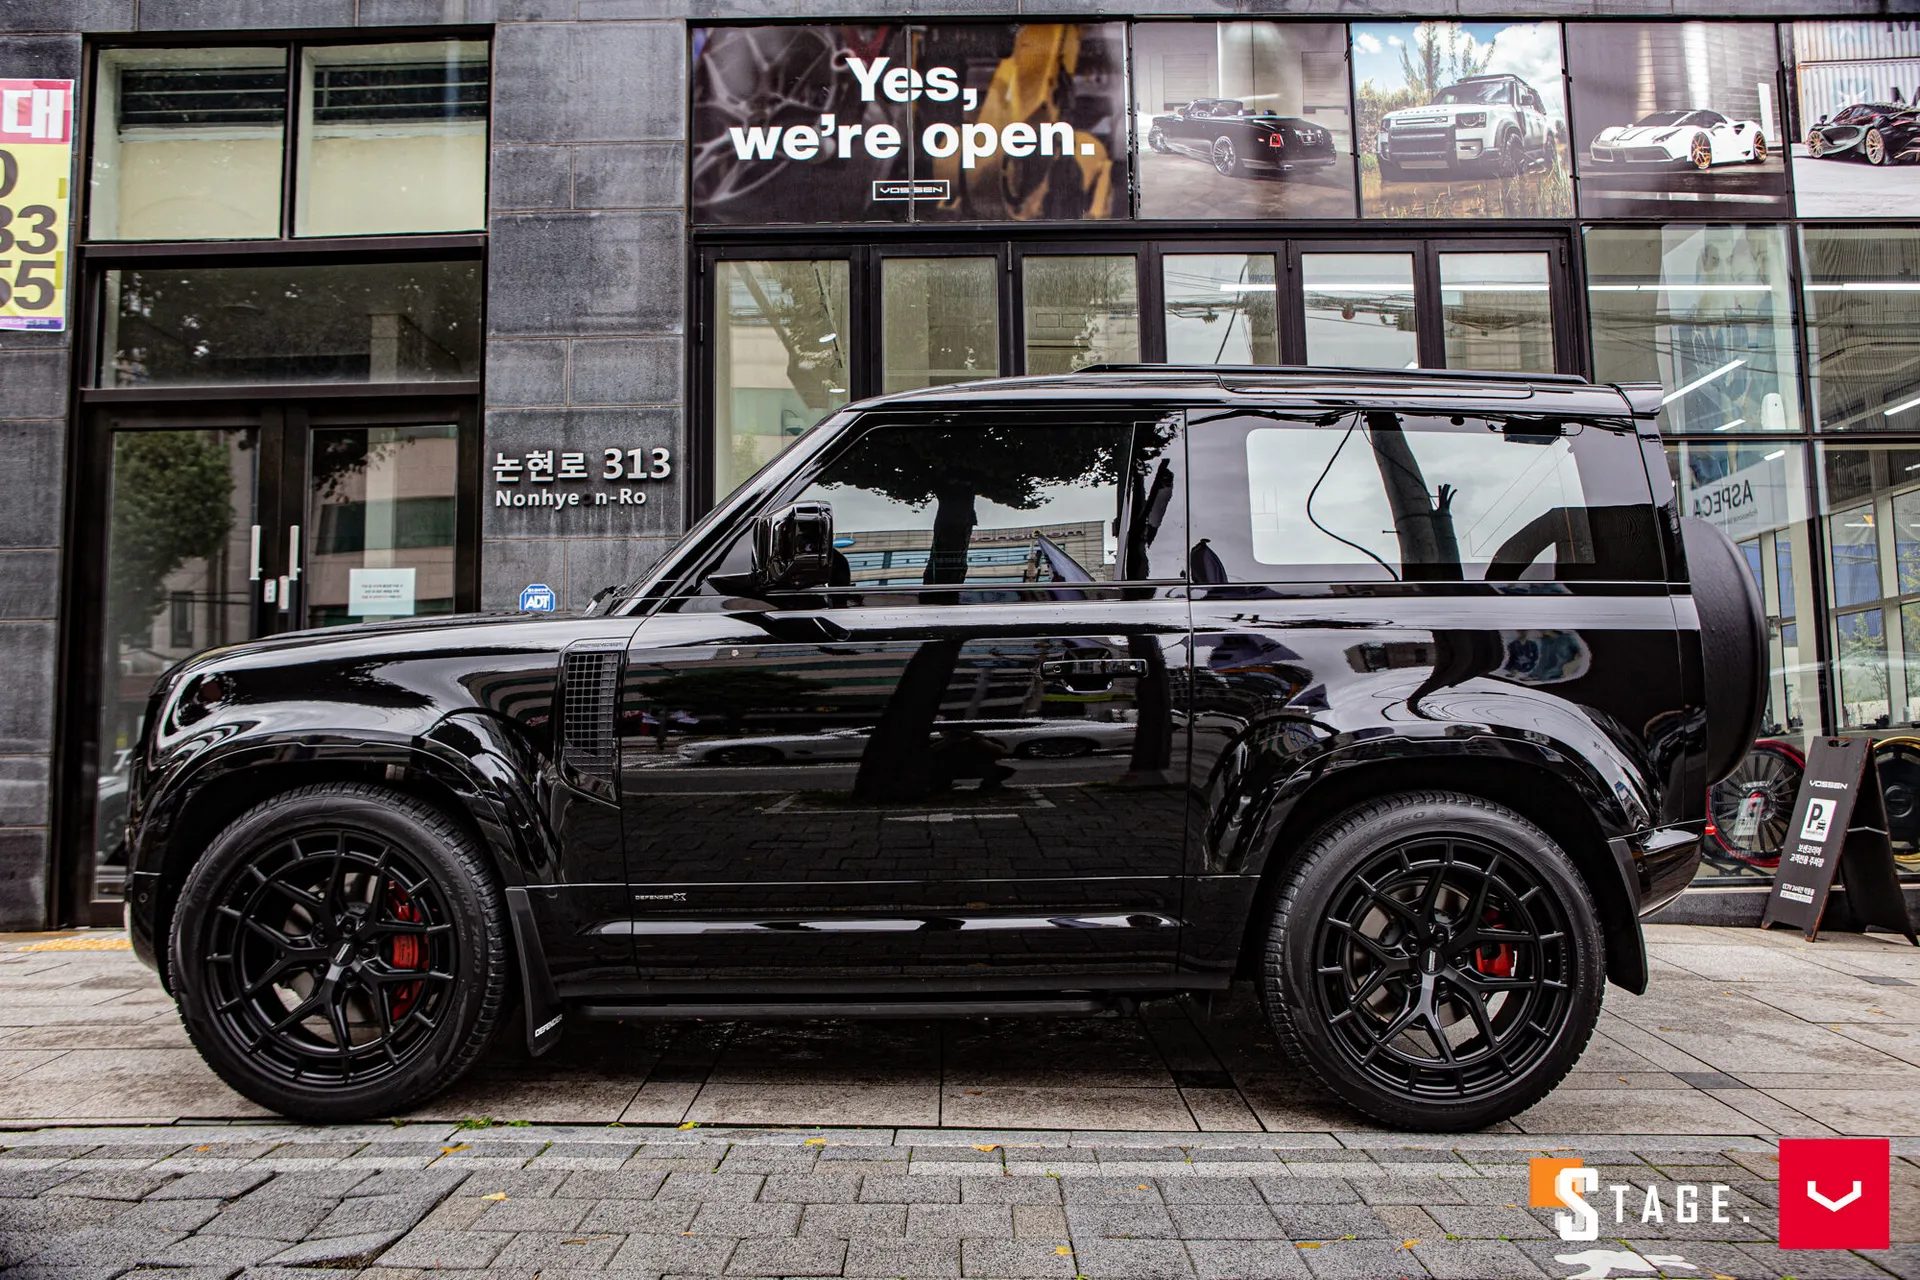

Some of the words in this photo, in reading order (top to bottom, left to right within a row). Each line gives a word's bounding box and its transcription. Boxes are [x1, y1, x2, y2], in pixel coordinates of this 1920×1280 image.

[845, 57, 978, 111] Yes,
[2, 89, 65, 139] 대
[729, 113, 902, 160] we're
[922, 121, 1095, 169] open.
[880, 186, 943, 194] VOSSEN
[492, 450, 589, 483] 논현로
[603, 447, 672, 480] 313
[525, 595, 550, 609] ADT
[1809, 780, 1848, 790] VOSSEN
[1806, 803, 1823, 829] P
